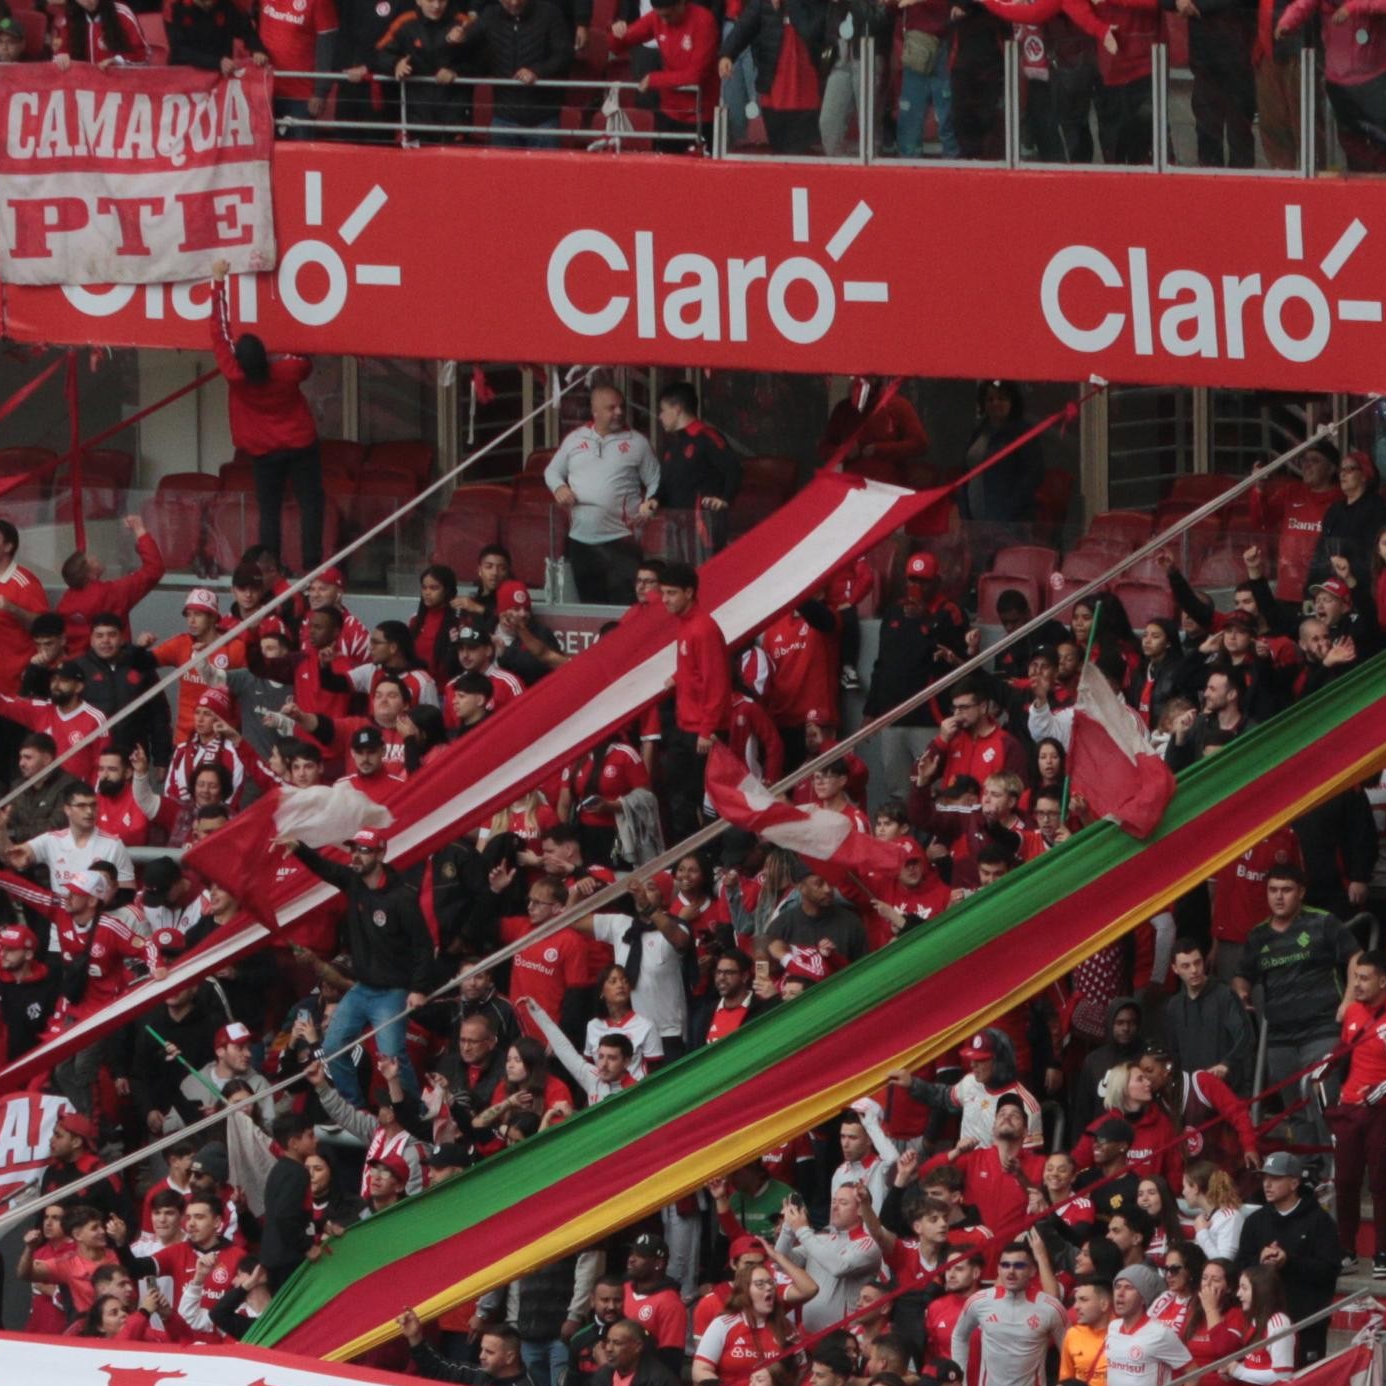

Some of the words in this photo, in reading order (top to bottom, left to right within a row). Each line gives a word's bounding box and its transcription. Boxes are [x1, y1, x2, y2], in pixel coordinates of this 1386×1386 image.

[7, 186, 254, 260] PTE
[546, 226, 836, 345] Claro
[1039, 243, 1331, 363] Claro
[553, 629, 600, 655] SET
